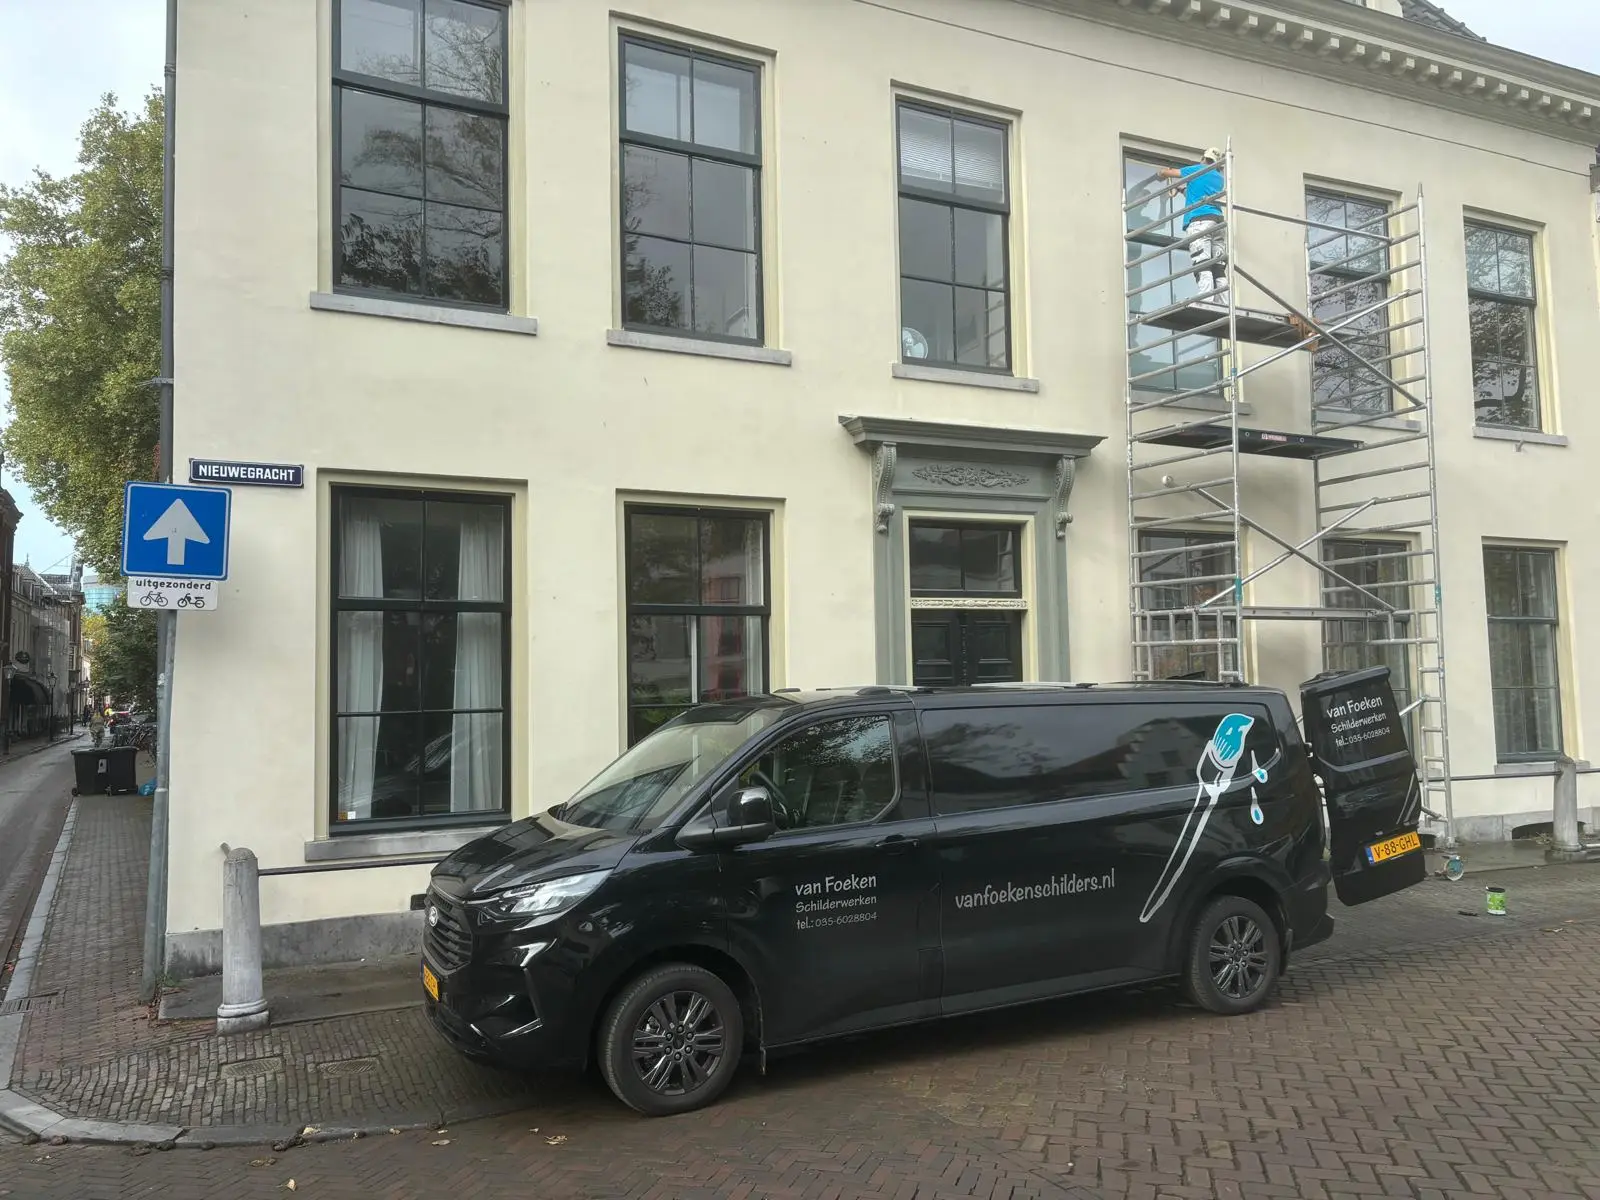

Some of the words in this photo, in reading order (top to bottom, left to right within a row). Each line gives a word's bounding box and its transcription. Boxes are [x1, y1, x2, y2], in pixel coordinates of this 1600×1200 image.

[198, 464, 295, 482] NIEUWEGRACHT
[136, 579, 211, 590] uitgezonderd
[1326, 705, 1347, 718] van
[1346, 696, 1383, 713] Foeken
[1331, 712, 1387, 733] Schilderwerken
[1348, 726, 1390, 744] 035-6028804
[1373, 834, 1418, 859] V-88-GHL
[795, 882, 822, 896] van
[825, 874, 877, 893] Foeken
[955, 867, 1115, 909] vanfoekenschilders.nl
[795, 895, 877, 913] Schilderwerken
[815, 911, 878, 928] 035-6028804
